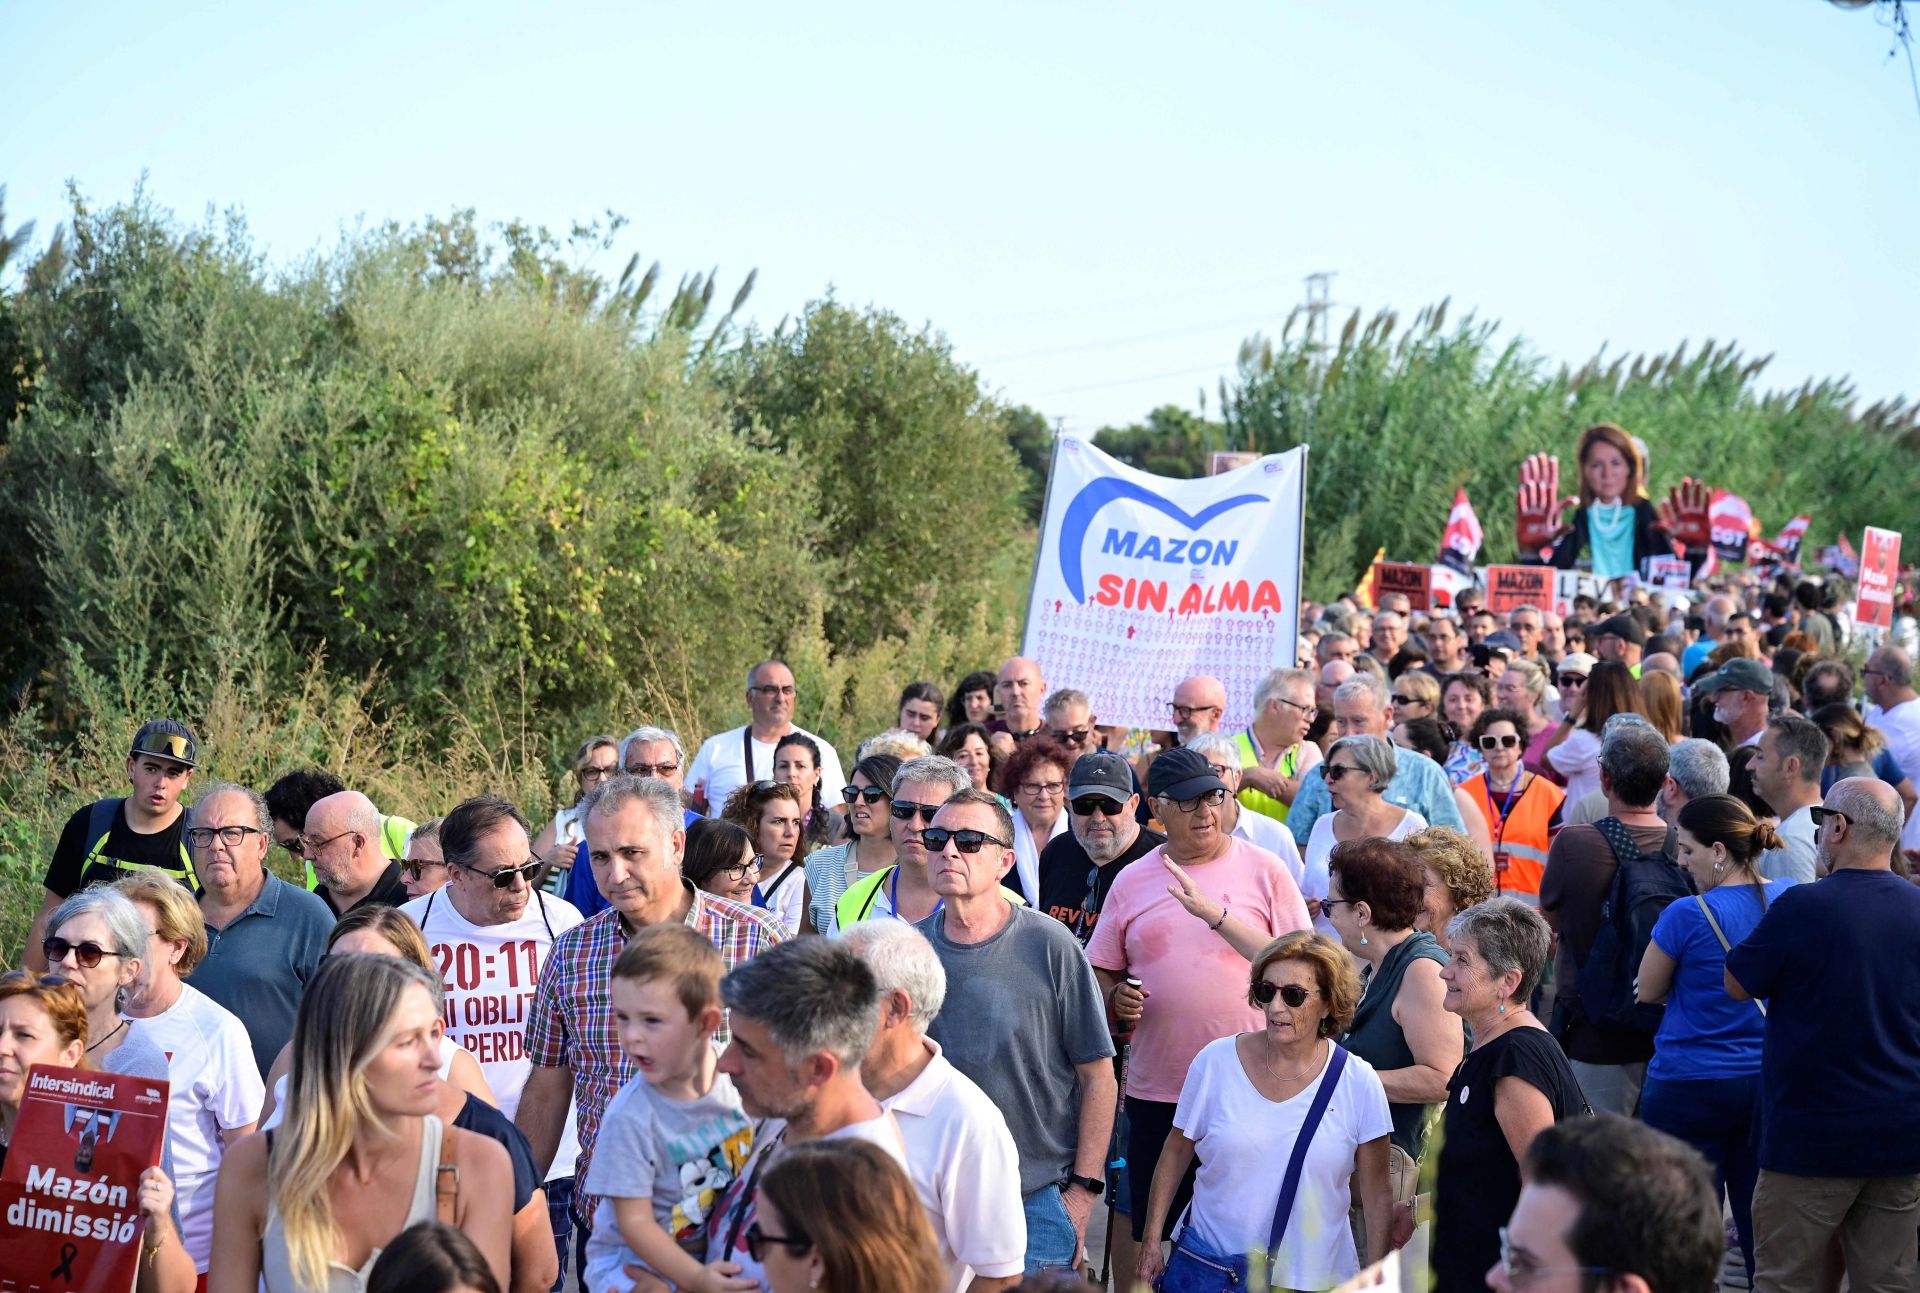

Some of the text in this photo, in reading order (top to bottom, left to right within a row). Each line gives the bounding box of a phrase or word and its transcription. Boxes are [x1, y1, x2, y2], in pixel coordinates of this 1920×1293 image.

[1101, 528, 1239, 566] MAZON
[1095, 573, 1282, 615] SIN ALMA
[1498, 571, 1543, 589] MAZON
[431, 940, 539, 991] 20:11
[463, 1031, 531, 1063] PERD
[30, 1072, 115, 1100] Intersindical
[25, 1164, 128, 1208] Mazón
[6, 1198, 138, 1243] dimissió
